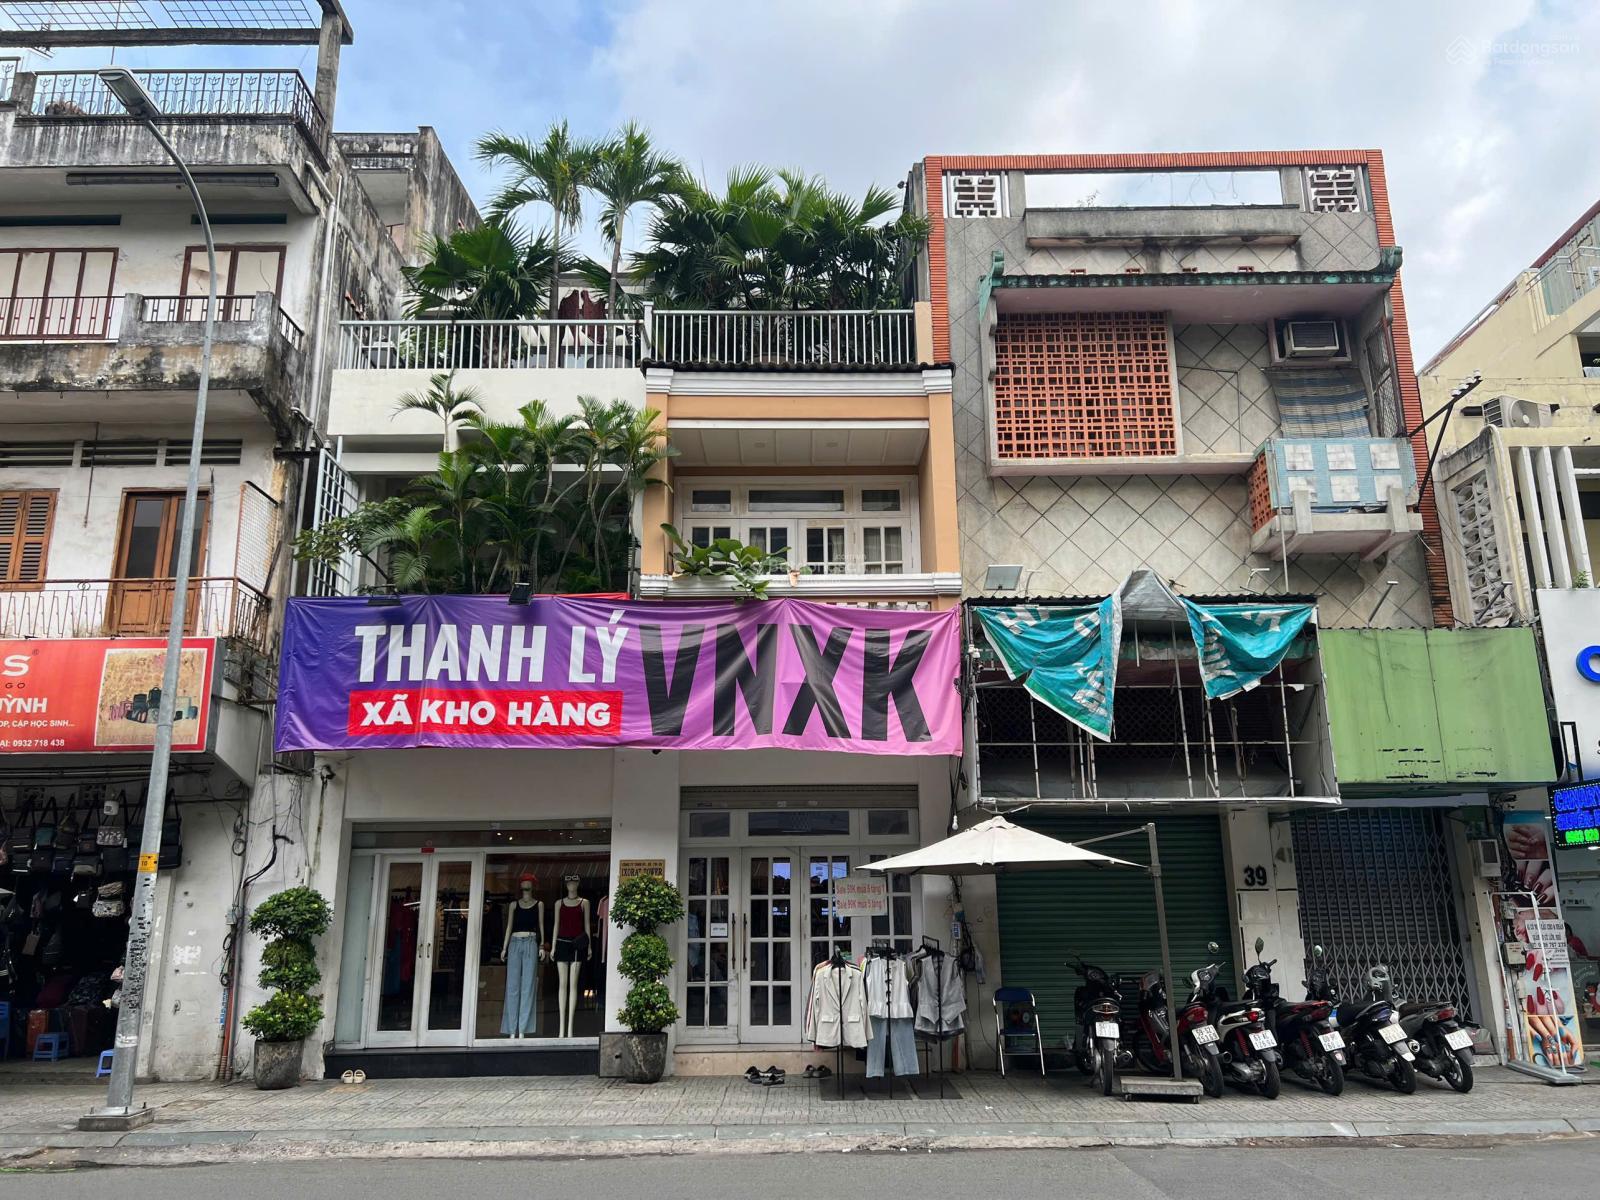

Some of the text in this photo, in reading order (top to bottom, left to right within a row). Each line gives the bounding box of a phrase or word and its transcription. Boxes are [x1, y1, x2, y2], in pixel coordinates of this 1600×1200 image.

[354, 610, 629, 683] THANH LÝ
[639, 623, 933, 743] VNXK
[0, 694, 48, 713] ỲNH
[360, 694, 611, 726] XÃ KHO HÀNG
[13, 739, 32, 747] 0932
[34, 739, 49, 747] 718
[50, 739, 65, 747] 438
[1243, 865, 1267, 887] 39
